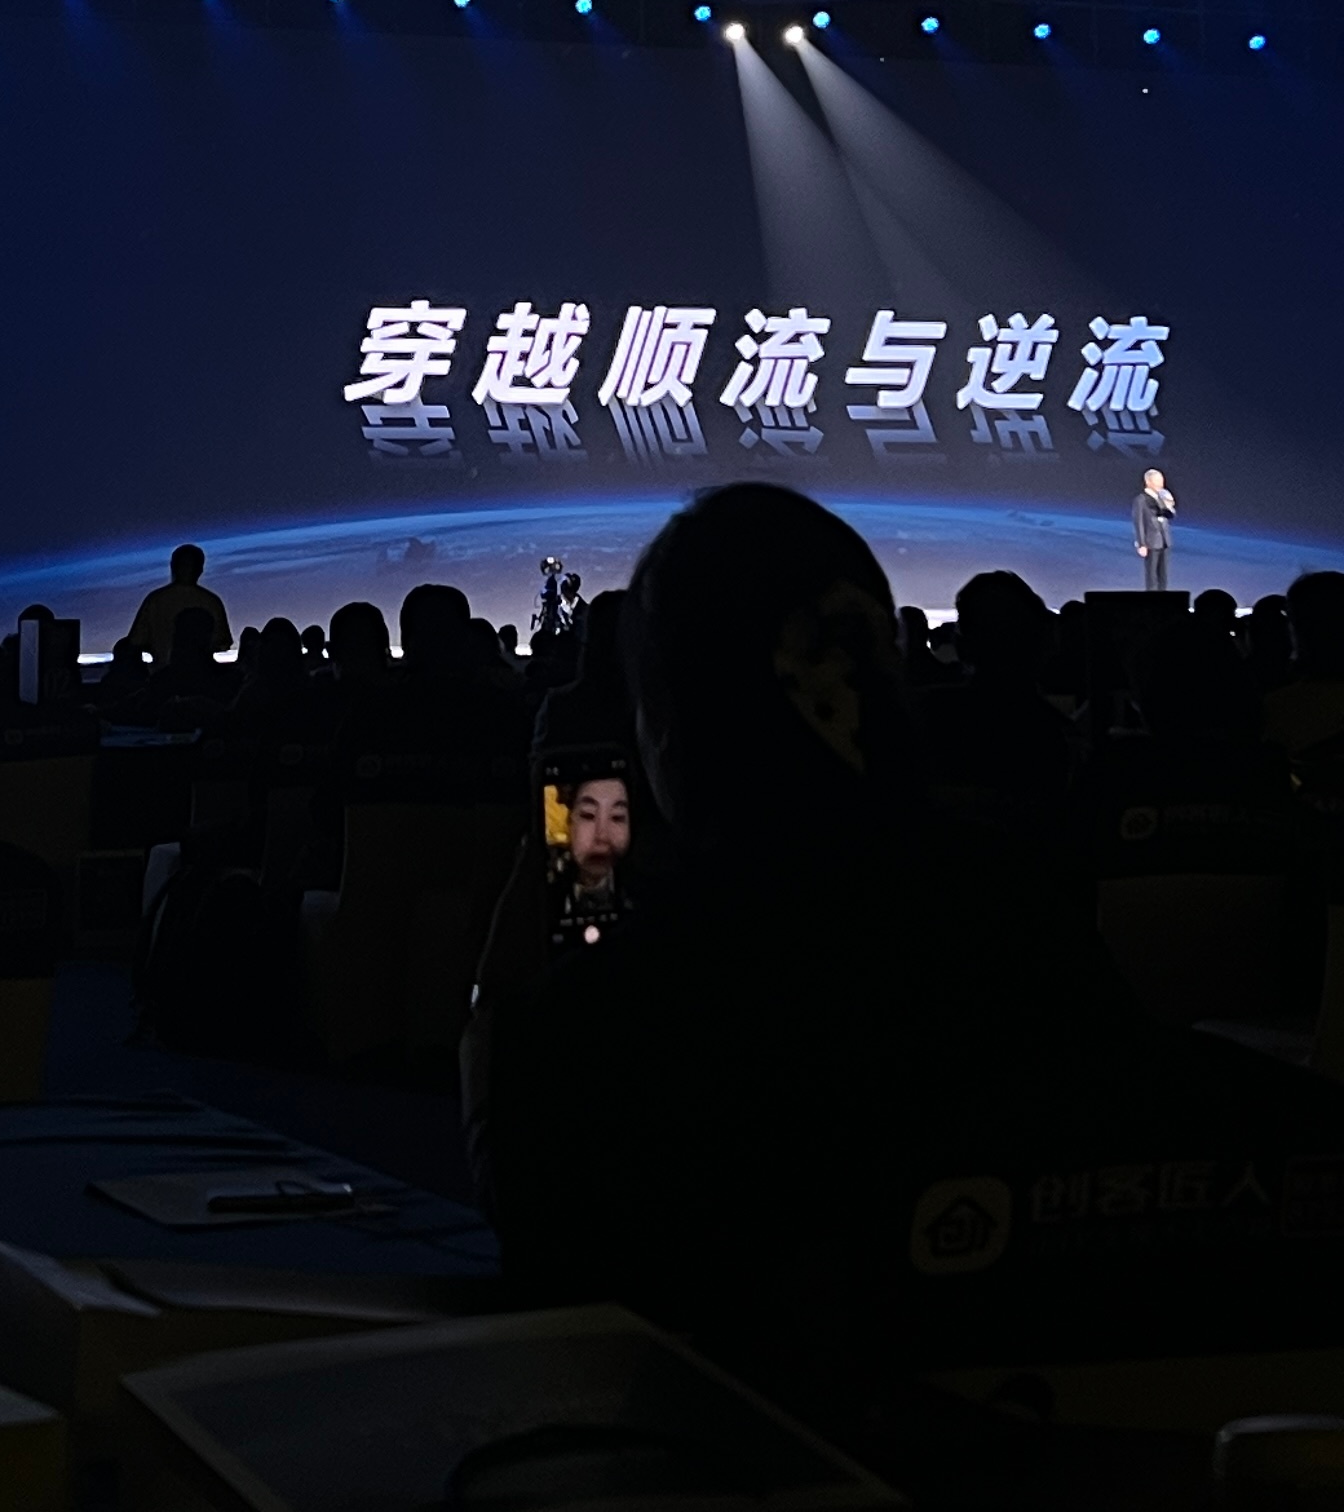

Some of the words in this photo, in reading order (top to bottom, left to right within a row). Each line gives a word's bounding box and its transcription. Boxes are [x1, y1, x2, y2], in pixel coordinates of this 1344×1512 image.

[343, 299, 1170, 412] 穿越顺流与逆流
